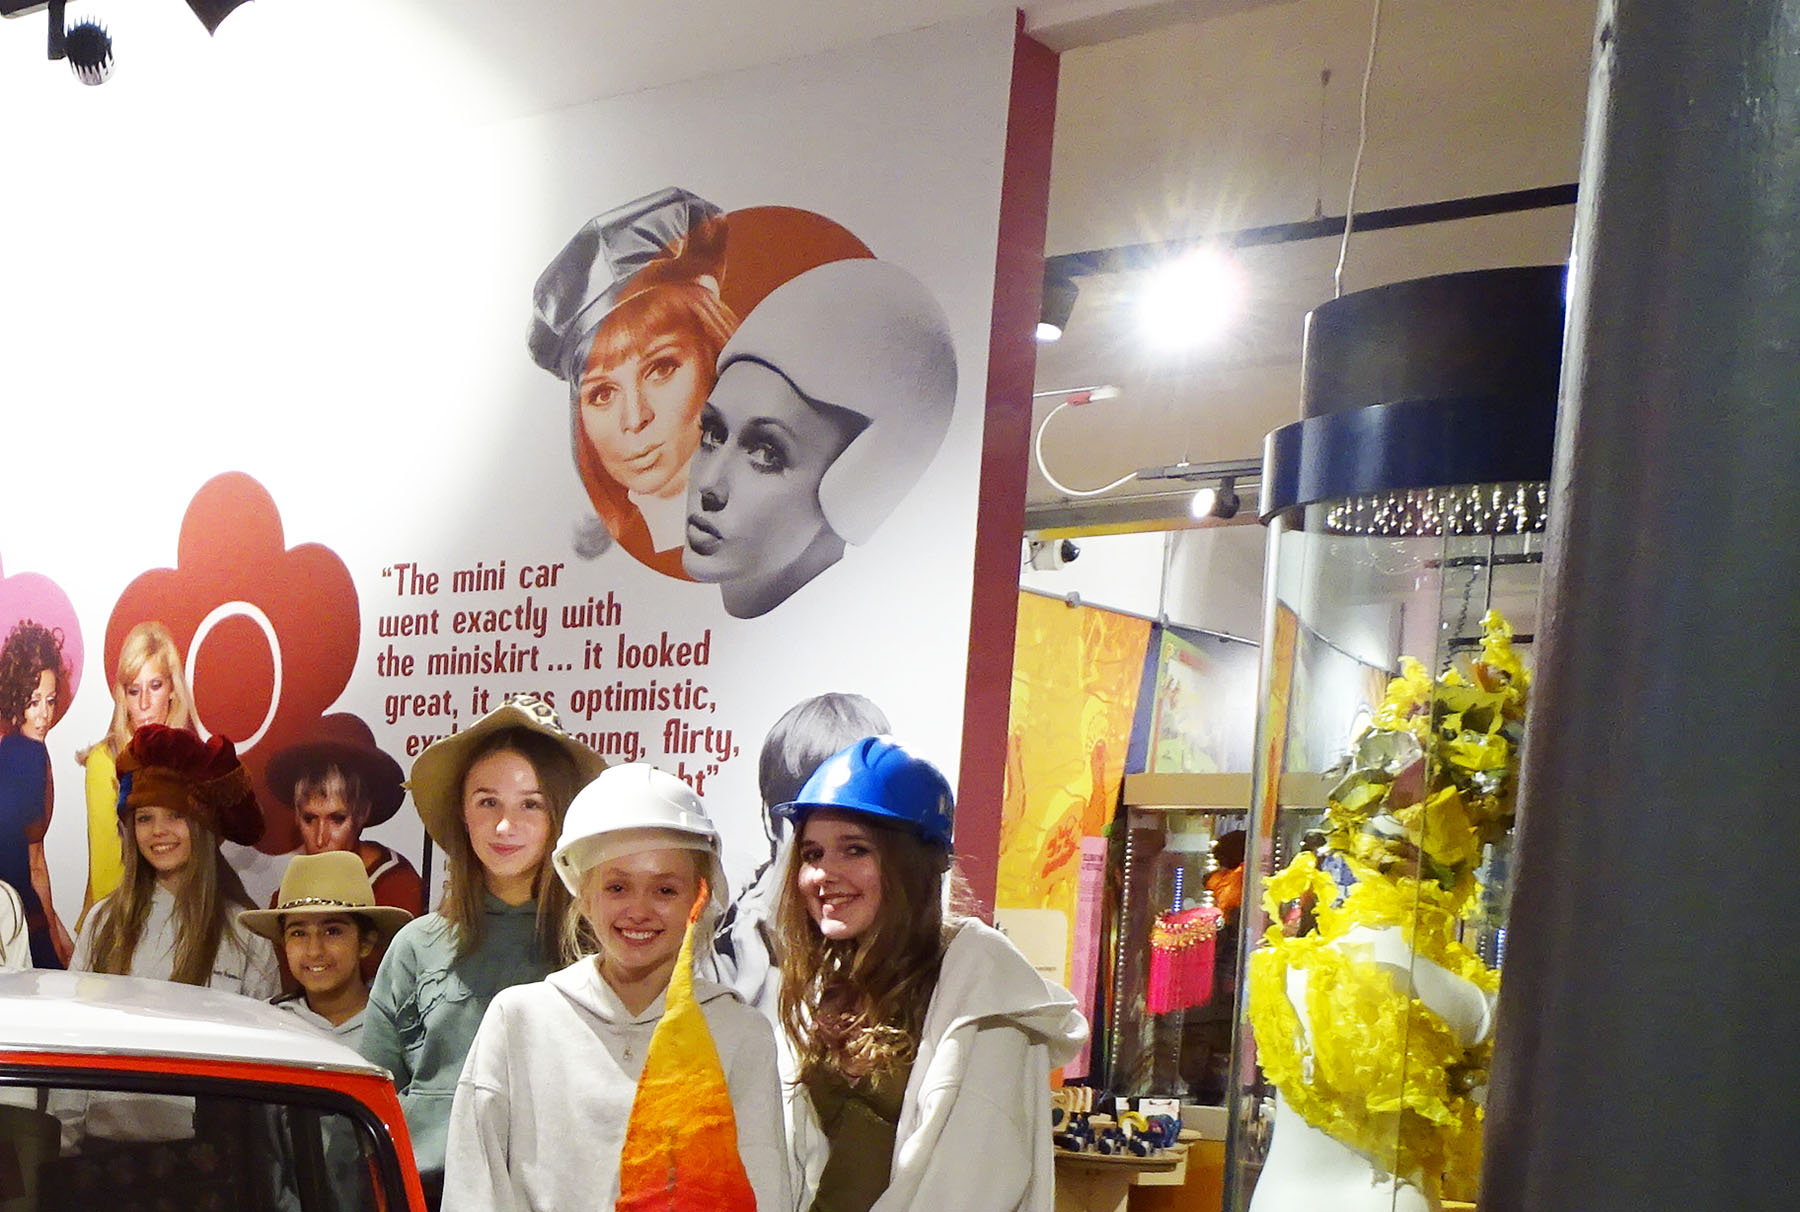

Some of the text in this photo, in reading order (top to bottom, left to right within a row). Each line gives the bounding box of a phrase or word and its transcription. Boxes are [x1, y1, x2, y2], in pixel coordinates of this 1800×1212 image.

[382, 560, 565, 596] “The mini car
[379, 591, 622, 638] went exactly with
[377, 644, 415, 677] the
[583, 639, 603, 670] it
[617, 629, 711, 669] looked
[385, 689, 458, 725] great,
[472, 686, 490, 715] it
[570, 678, 716, 720] optimistic,
[663, 718, 740, 762] flirty,
